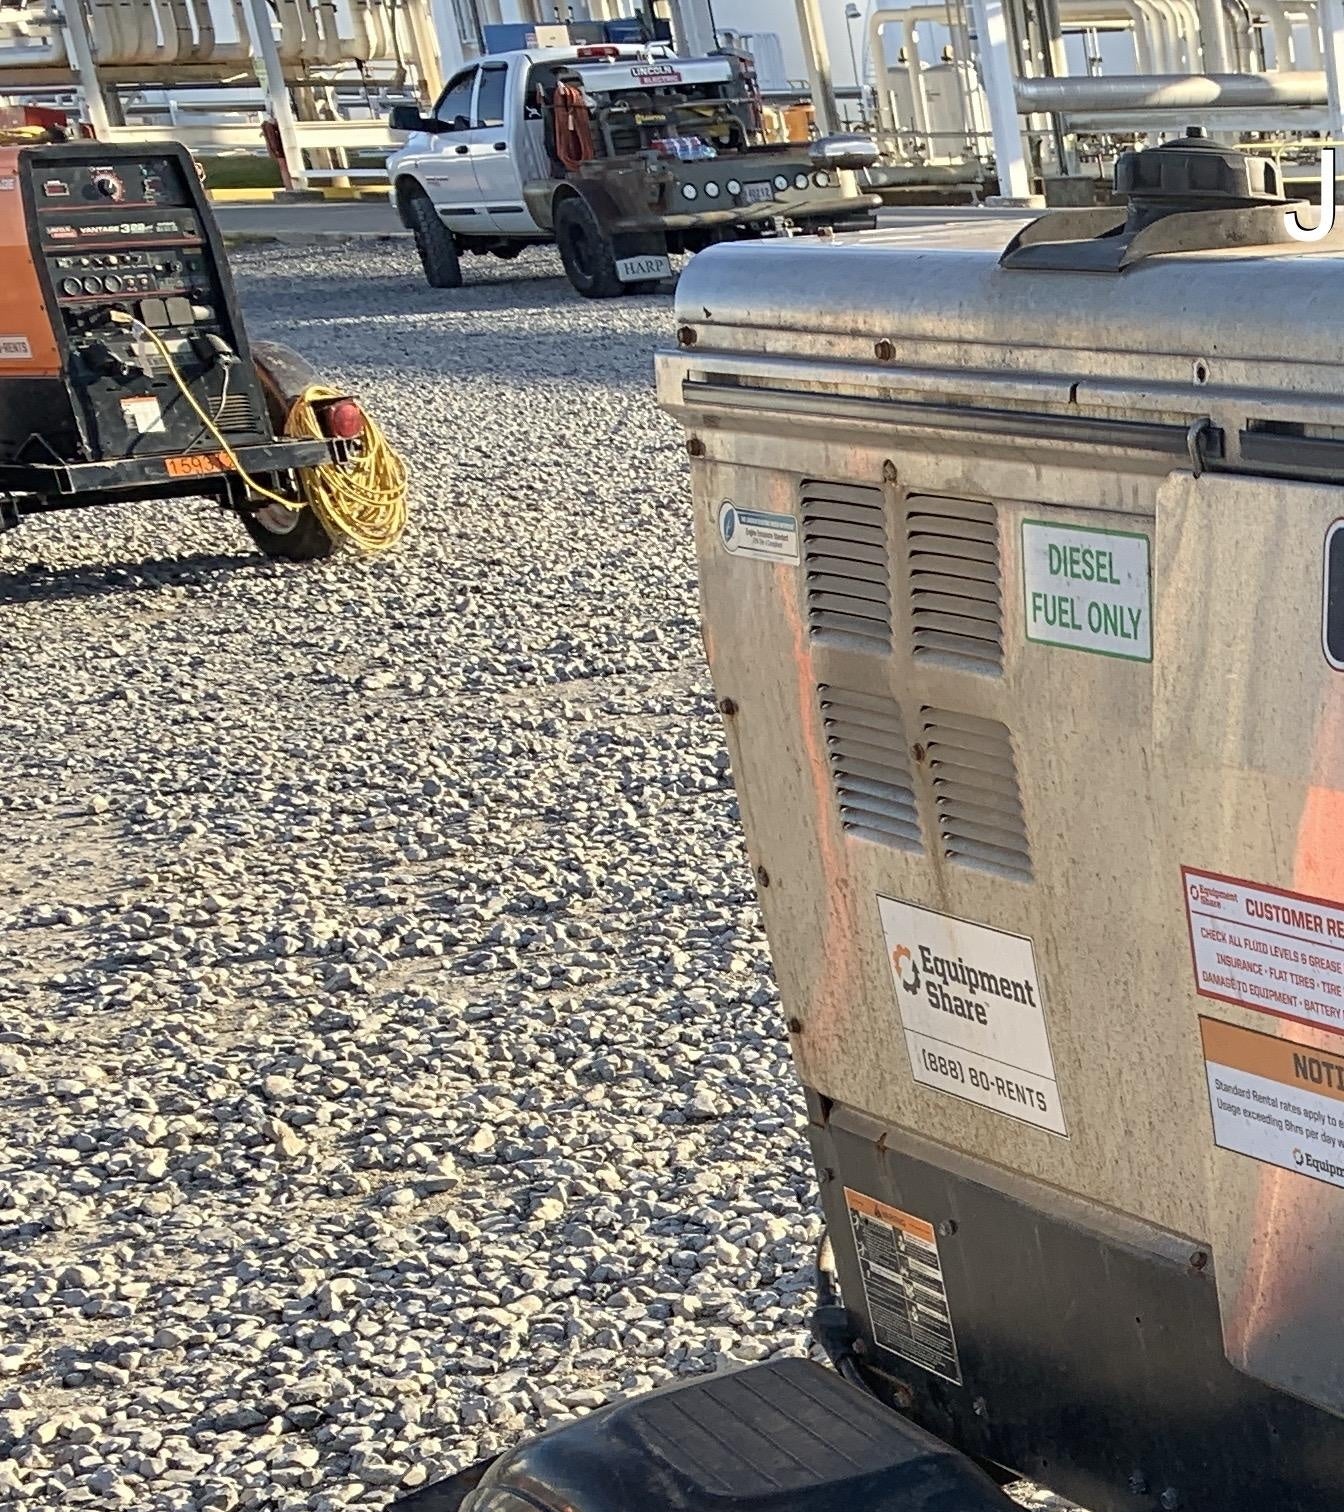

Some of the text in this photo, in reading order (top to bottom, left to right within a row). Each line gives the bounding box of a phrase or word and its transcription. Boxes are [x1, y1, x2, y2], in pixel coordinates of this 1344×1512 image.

[624, 259, 664, 276] HARP
[1048, 543, 1121, 585] DIESEL
[1032, 592, 1142, 640] FUEL ONLY
[1245, 898, 1323, 934] CUSTOMER
[1200, 927, 1227, 943] CHECK
[1229, 935, 1242, 948] ALL
[1244, 938, 1268, 955] FLUID
[1270, 946, 1299, 962] LEVELS
[1309, 954, 1343, 975] GREASE
[1216, 952, 1263, 976] INSURANCE
[1269, 967, 1287, 981] FLAT
[1290, 972, 1315, 989] TIRES
[1321, 981, 1342, 997] TIRE
[918, 945, 1037, 1008] Equipment
[1202, 970, 1237, 990] DAMAGE
[1236, 981, 1248, 993] TO
[1249, 983, 1298, 1007] EQUIPMENT
[1304, 999, 1341, 1019] BATTERY
[925, 981, 988, 1025] Share
[922, 1049, 1047, 1112] (888) 80-RENTS
[1215, 1079, 1251, 1099] Standard
[1252, 1090, 1278, 1108] Rental
[1280, 1100, 1302, 1116] rates
[1303, 1108, 1325, 1126] apply
[1327, 1115, 1337, 1127] to
[1217, 1097, 1242, 1116] Usage
[1243, 1108, 1284, 1131] exceeding
[1305, 1128, 1319, 1139] per
[1320, 1131, 1336, 1148] day
